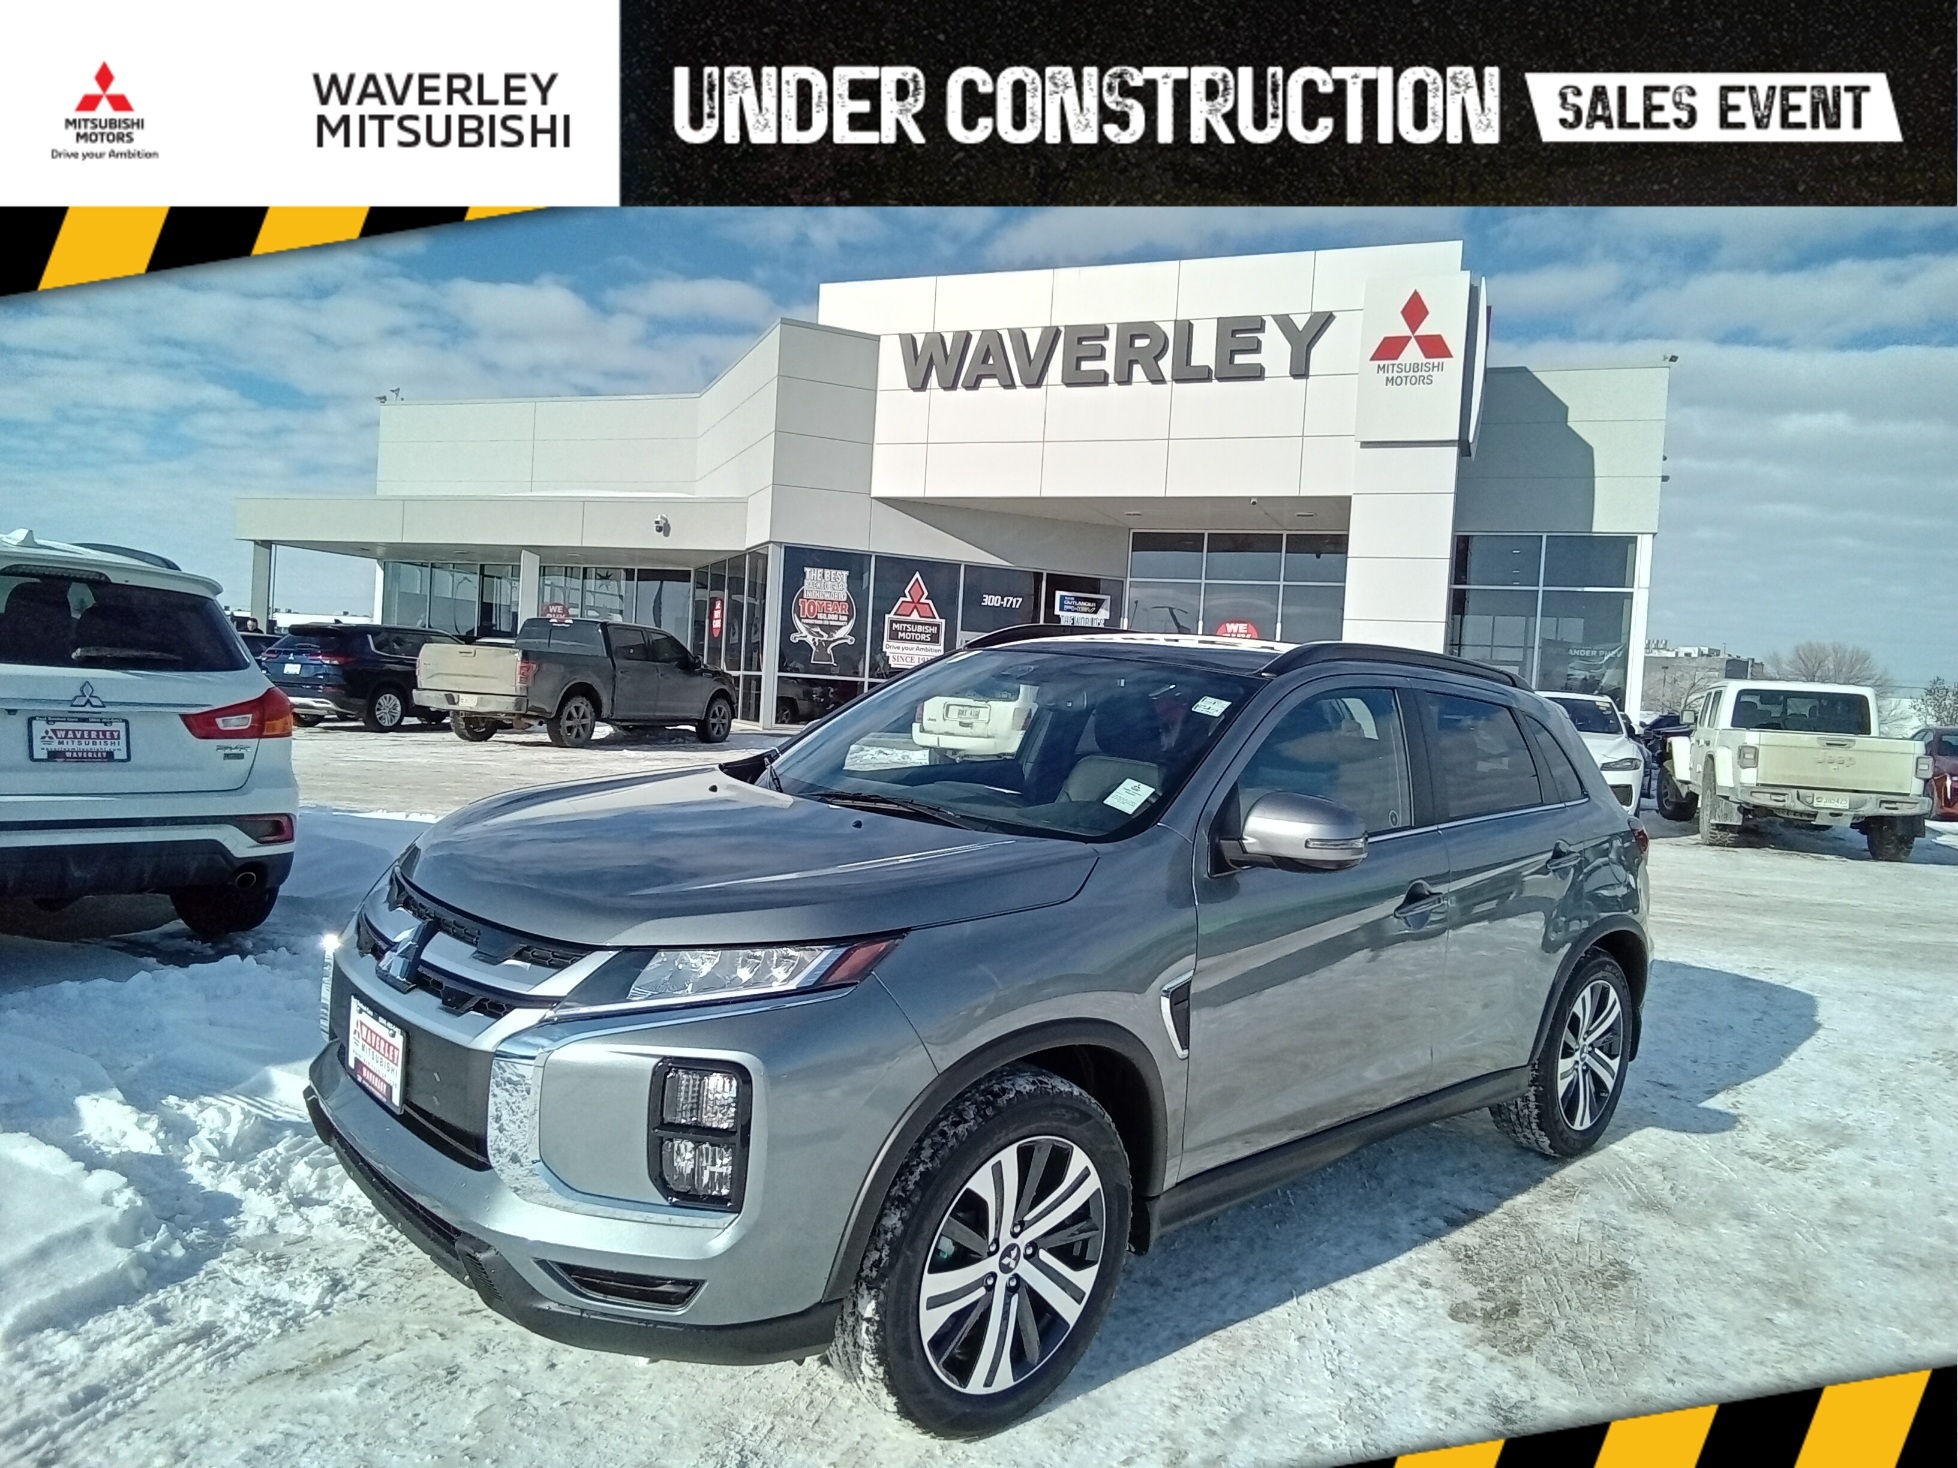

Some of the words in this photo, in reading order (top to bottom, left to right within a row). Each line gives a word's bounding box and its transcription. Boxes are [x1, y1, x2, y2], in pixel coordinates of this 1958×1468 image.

[899, 311, 1335, 391] WAVERLEY
[1376, 361, 1444, 374] MITSUBISHI
[1385, 374, 1434, 386] MOTORS
[804, 567, 823, 580] THE
[824, 569, 849, 582] BEST
[824, 591, 847, 600] WORLD
[981, 594, 1022, 609] 300-1717
[549, 605, 563, 613] WE
[799, 599, 817, 618] 10
[816, 601, 849, 614] YEAR
[892, 622, 938, 634] MITSUBISHI
[1225, 623, 1248, 633] WE
[898, 631, 931, 642] MOTORS
[892, 655, 915, 663] SINCE
[56, 729, 119, 739] WAVERLEY
[360, 1023, 399, 1065] WAVERLEY
[361, 1042, 399, 1078] MITSUBISHI
[362, 1066, 387, 1094] WAVERLEY
